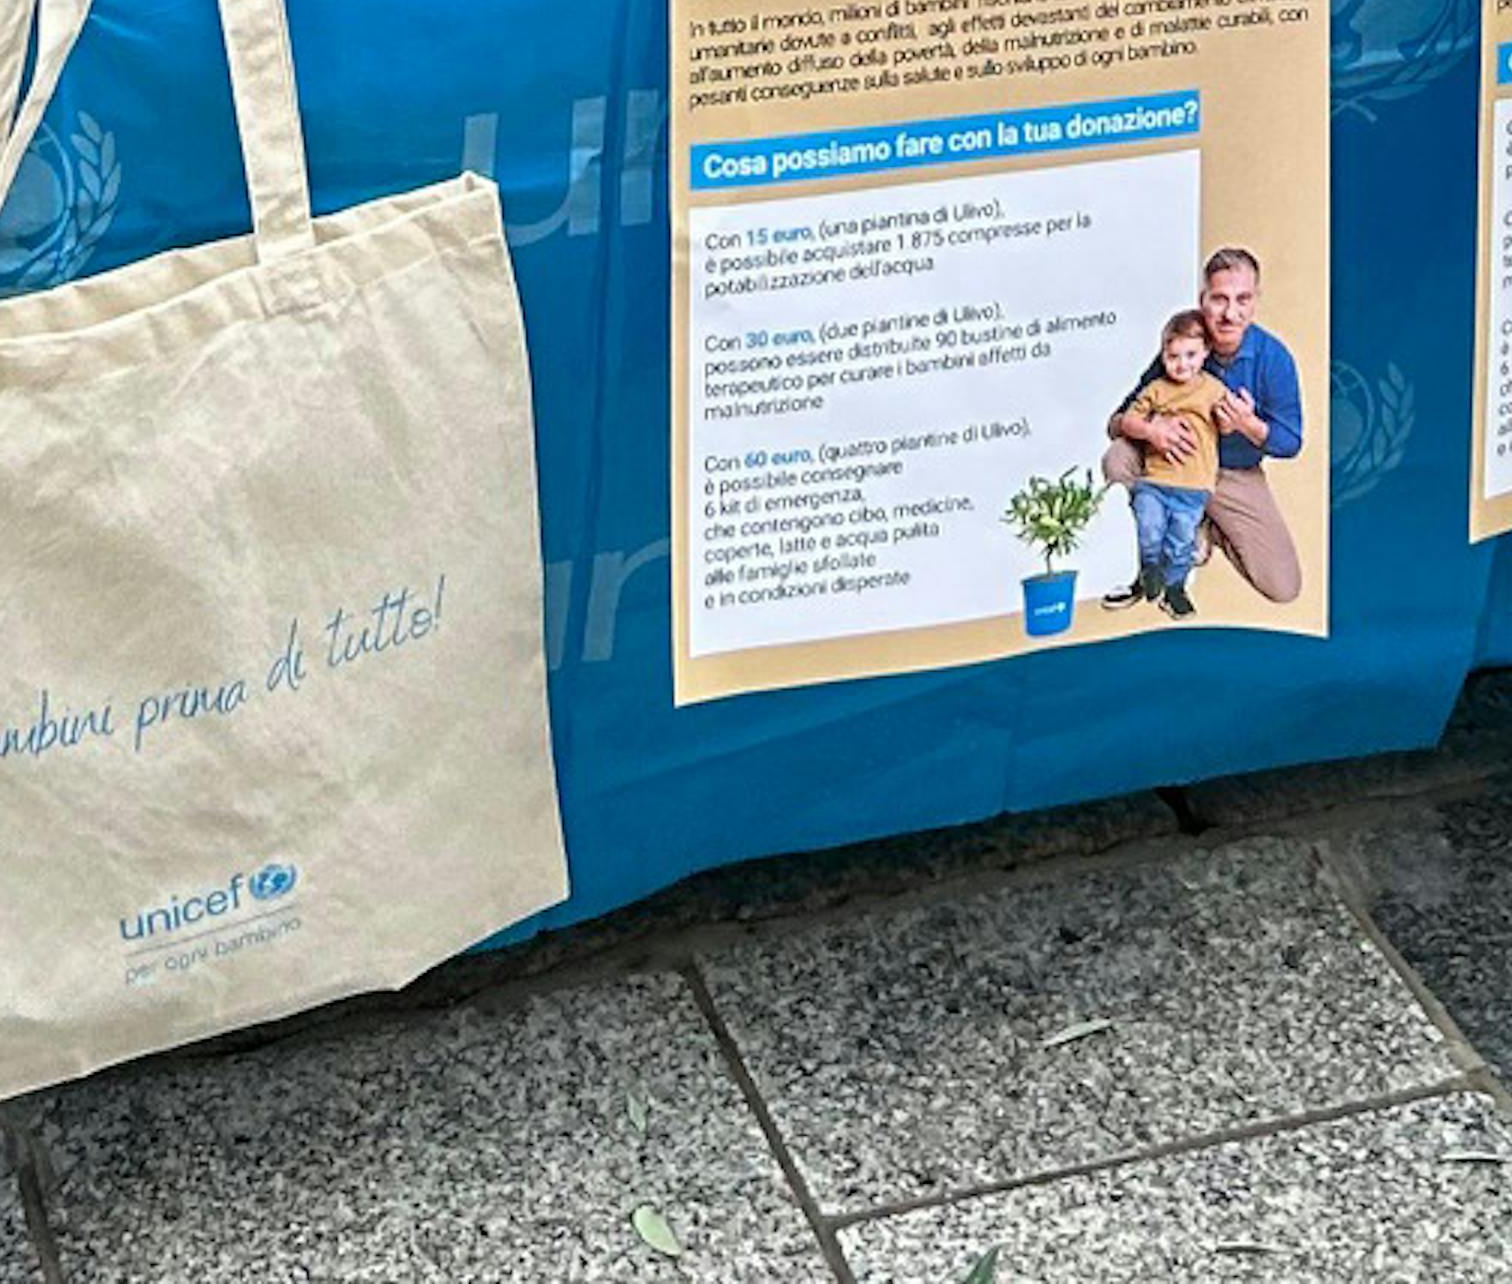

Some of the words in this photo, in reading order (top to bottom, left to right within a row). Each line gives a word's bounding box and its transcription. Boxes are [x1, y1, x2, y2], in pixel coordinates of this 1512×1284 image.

[703, 152, 766, 181] Cosa
[772, 139, 891, 179] possiamo
[895, 131, 943, 159] fare
[947, 128, 992, 152] con
[997, 120, 1018, 147] la
[1022, 116, 1062, 144] tua
[1065, 97, 1198, 139] donazione?
[135, 679, 247, 752] prima
[266, 617, 307, 693] di
[326, 574, 445, 668] tutto!
[120, 873, 244, 941] unicef
[125, 963, 158, 986] per
[163, 945, 208, 975] ogni
[215, 916, 302, 958] bambino
